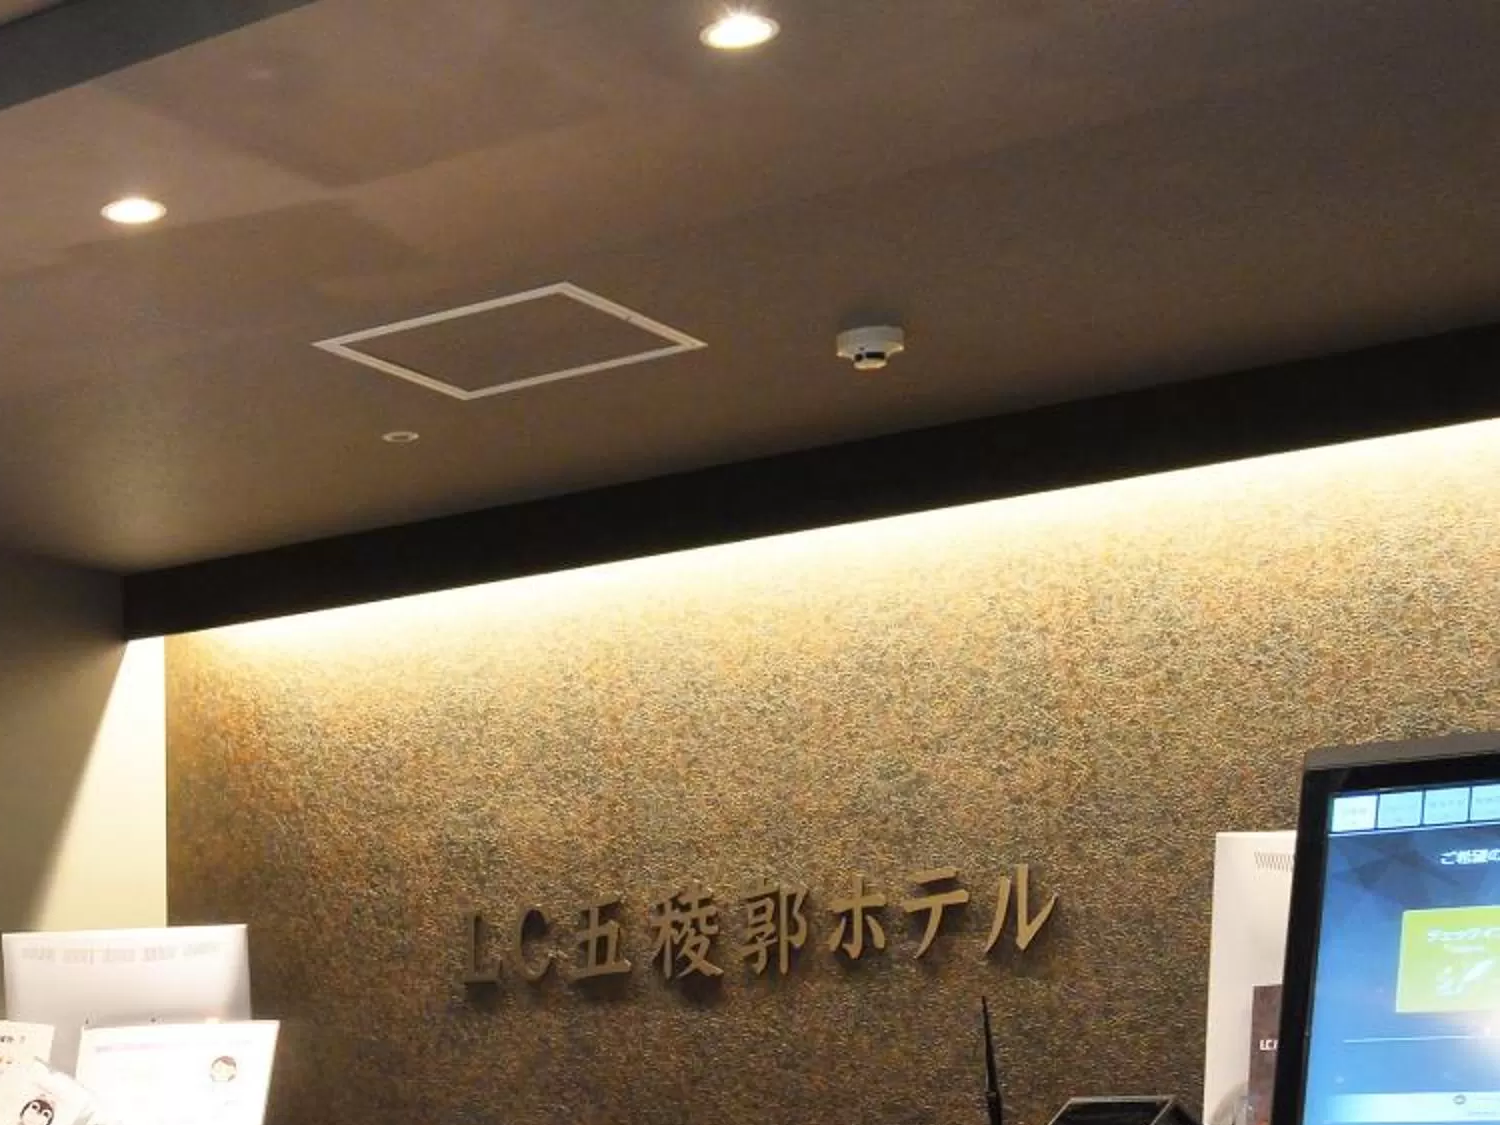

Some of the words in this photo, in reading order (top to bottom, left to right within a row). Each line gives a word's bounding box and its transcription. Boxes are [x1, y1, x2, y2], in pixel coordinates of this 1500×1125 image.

[461, 863, 1059, 986] LC五稜郭ホテル
